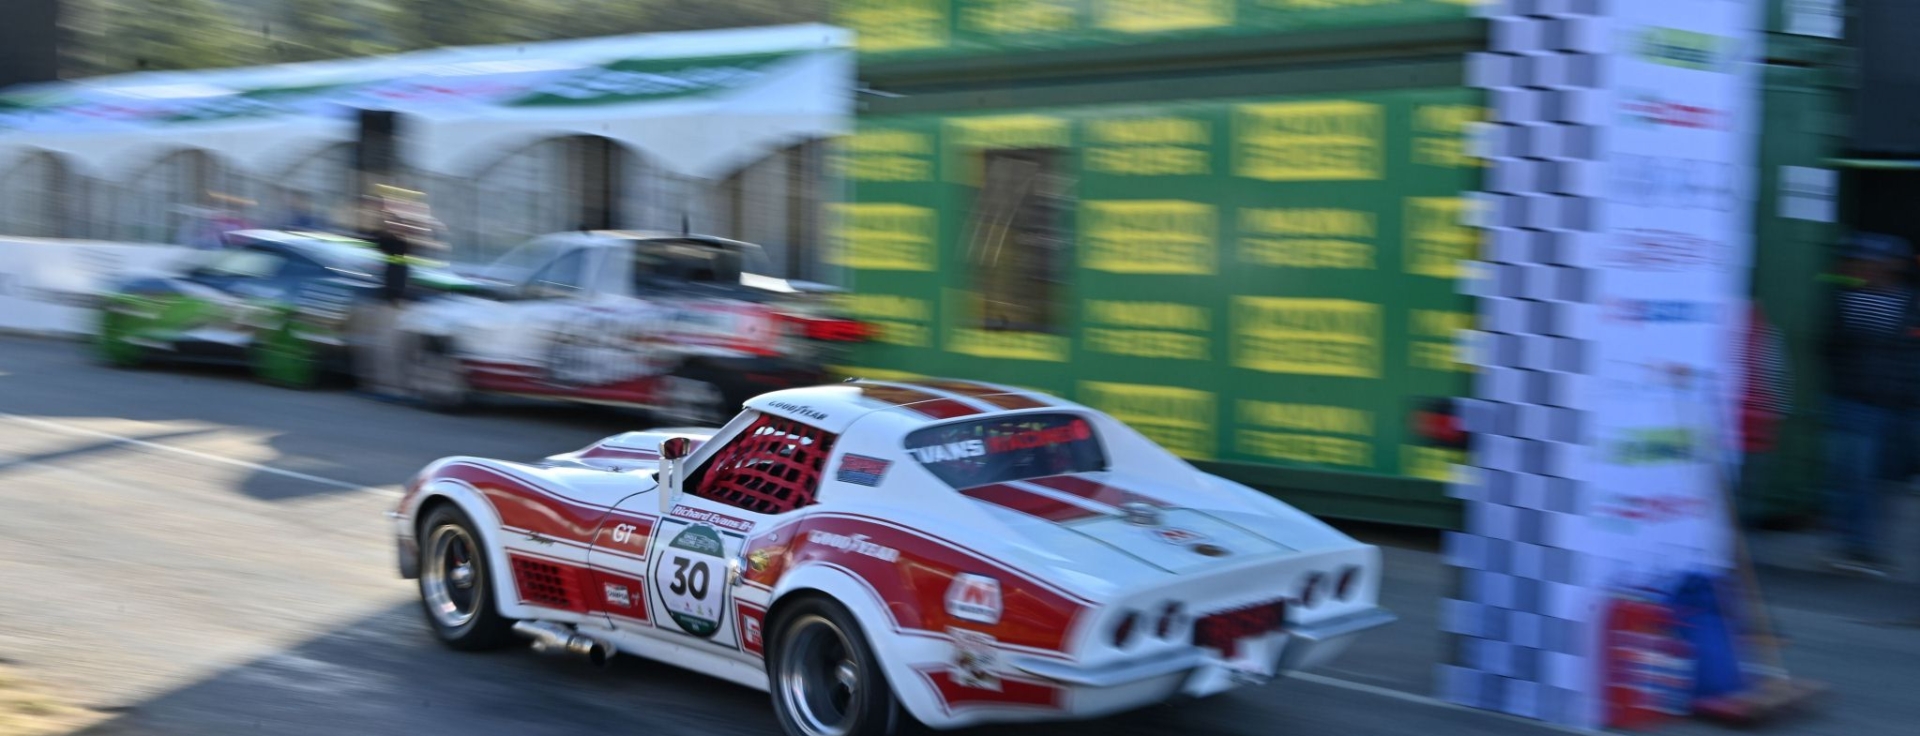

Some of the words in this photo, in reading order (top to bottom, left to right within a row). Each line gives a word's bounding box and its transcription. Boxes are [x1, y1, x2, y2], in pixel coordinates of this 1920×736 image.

[768, 400, 829, 420] GOODYEAR
[672, 506, 711, 521] Richard
[709, 514, 742, 528] Evans
[613, 523, 637, 544] GT
[669, 556, 710, 600] 30
